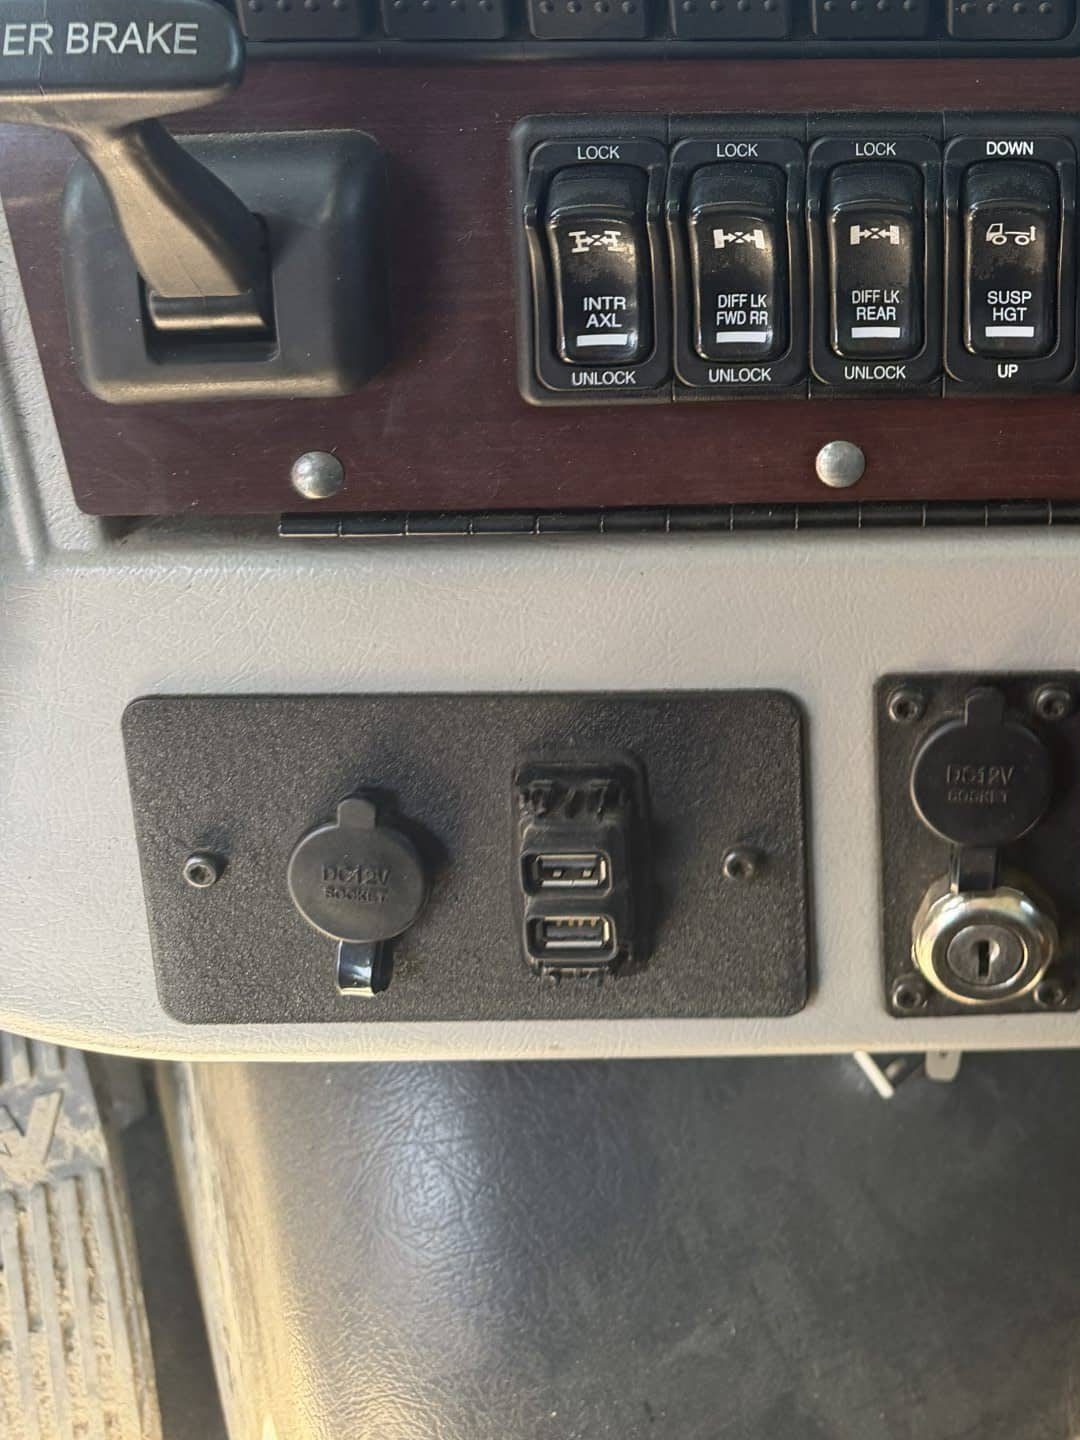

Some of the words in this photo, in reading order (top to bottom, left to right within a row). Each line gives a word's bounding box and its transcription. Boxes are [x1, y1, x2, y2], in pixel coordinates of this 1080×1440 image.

[66, 21, 199, 54] BRAKE
[577, 146, 620, 160] LOCK
[716, 144, 758, 157] LOCK
[855, 142, 897, 156] LOCK
[986, 141, 1034, 155] DOWN
[584, 296, 626, 310] INTR
[718, 294, 747, 308] DIFF
[751, 294, 767, 308] LK
[852, 290, 880, 304] DIFF
[884, 290, 900, 304] LK
[987, 290, 1032, 304] SUSP
[586, 313, 622, 327] AXL
[716, 311, 746, 326] FWD
[750, 311, 768, 326] RR
[856, 306, 896, 320] REAR
[992, 307, 1027, 321] HGT
[708, 367, 772, 383] UNLOCK
[844, 365, 906, 380] UNLOCK
[997, 364, 1018, 378] UP
[572, 371, 636, 386] UNLOCK
